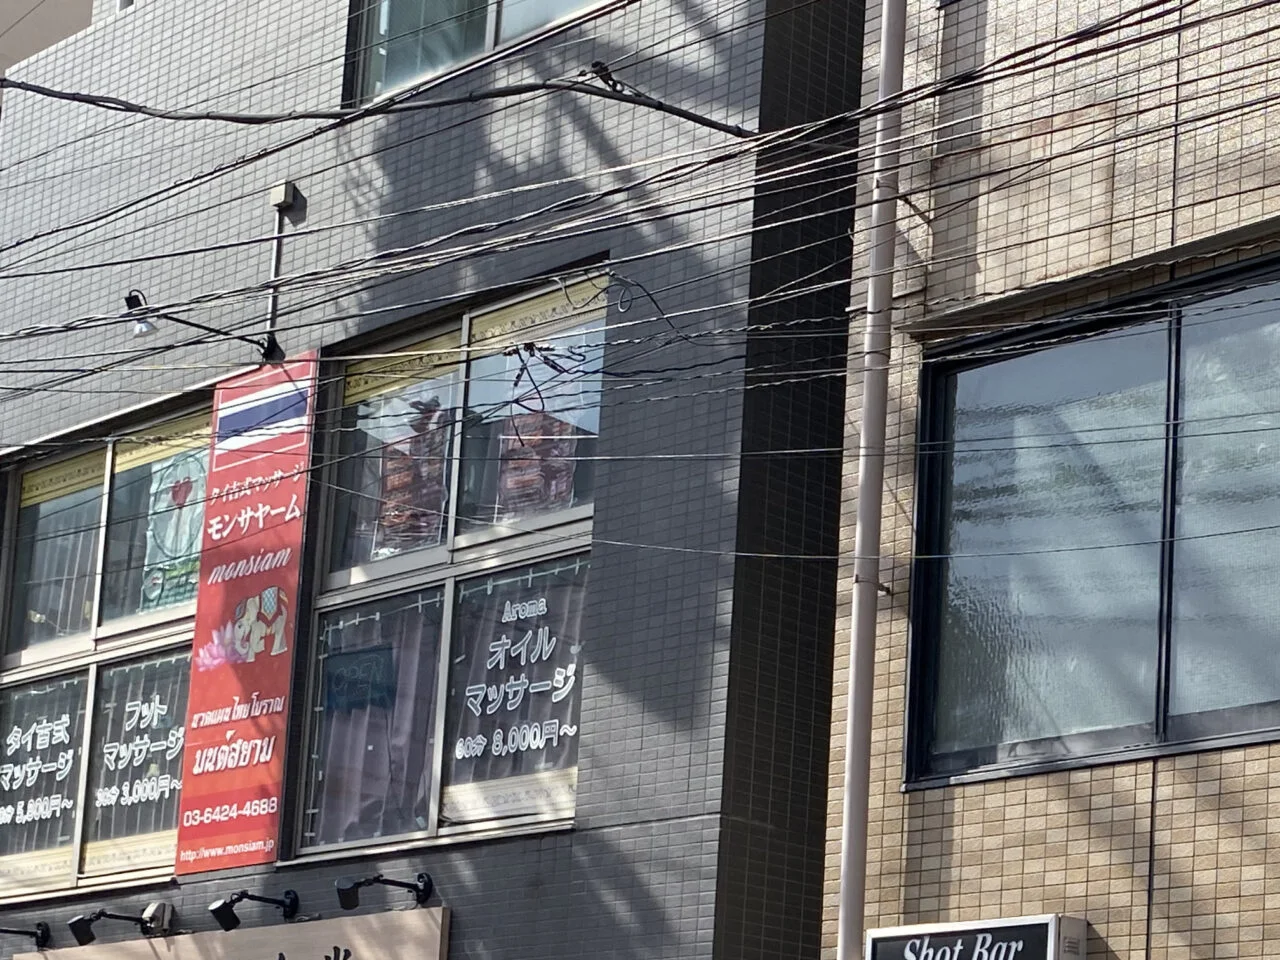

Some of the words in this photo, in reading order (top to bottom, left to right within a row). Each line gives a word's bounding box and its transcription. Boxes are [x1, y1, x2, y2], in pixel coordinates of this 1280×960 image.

[207, 494, 301, 540] モンサヤーム
[207, 547, 291, 585] monsiam
[501, 598, 547, 623] Aroma
[487, 626, 556, 670] オイル
[465, 663, 577, 716] マッサージ
[125, 695, 168, 731] フット
[6, 714, 70, 756] タイ古式
[103, 727, 185, 771] マッサージ
[0, 749, 74, 791] マッサージ
[183, 797, 278, 827] 03-6424-4688
[180, 838, 274, 863] http://www.monsiam.jp
